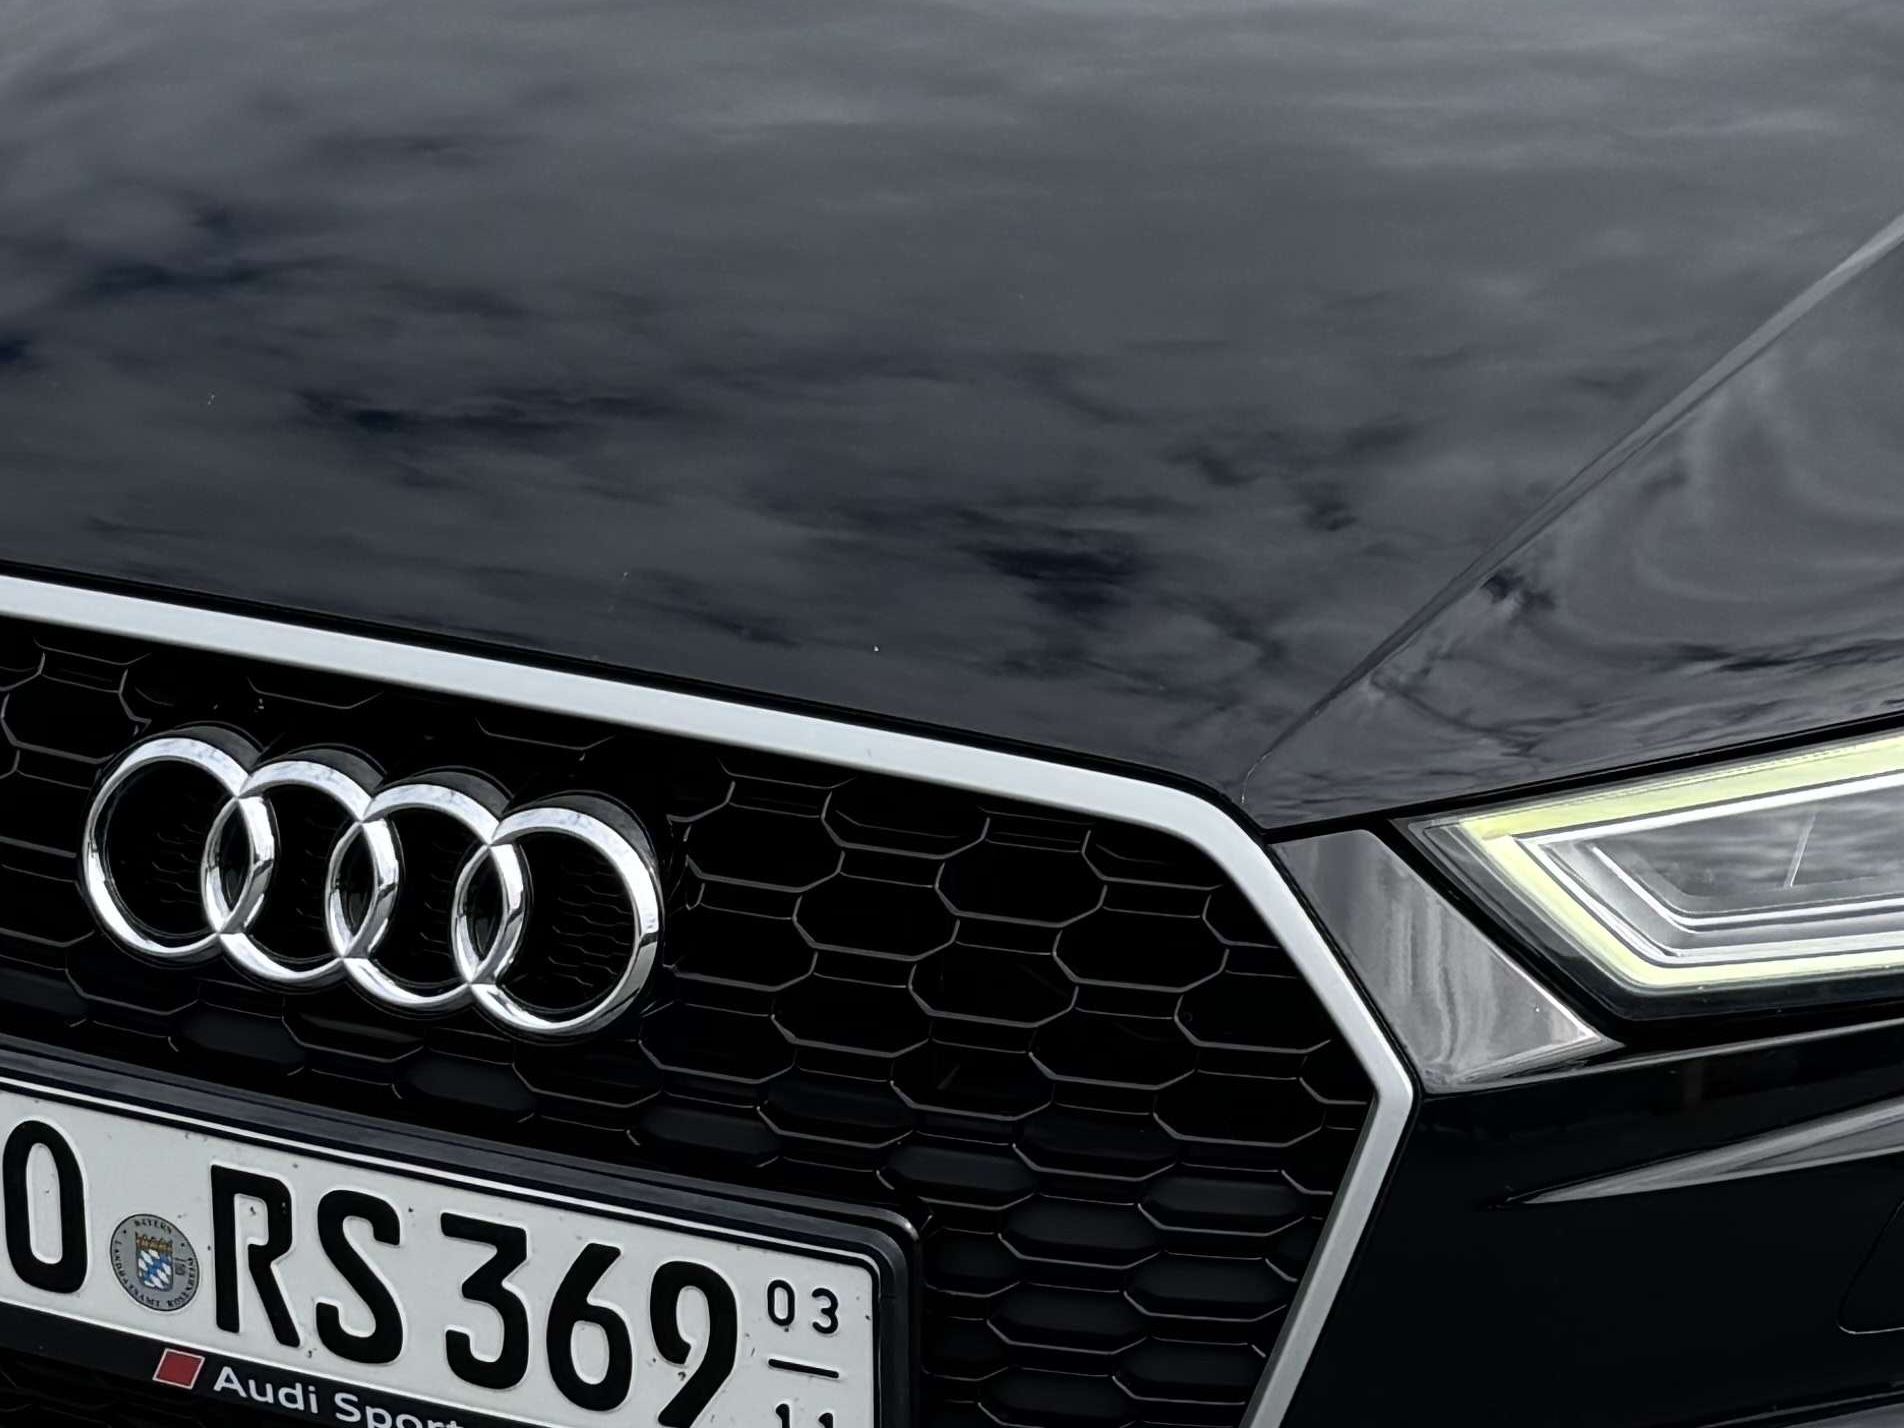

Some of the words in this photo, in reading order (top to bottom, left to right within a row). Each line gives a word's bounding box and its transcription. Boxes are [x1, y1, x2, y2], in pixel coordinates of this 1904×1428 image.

[209, 1163, 404, 1366] RS
[767, 1278, 840, 1335] 03
[213, 1366, 320, 1414] Audi
